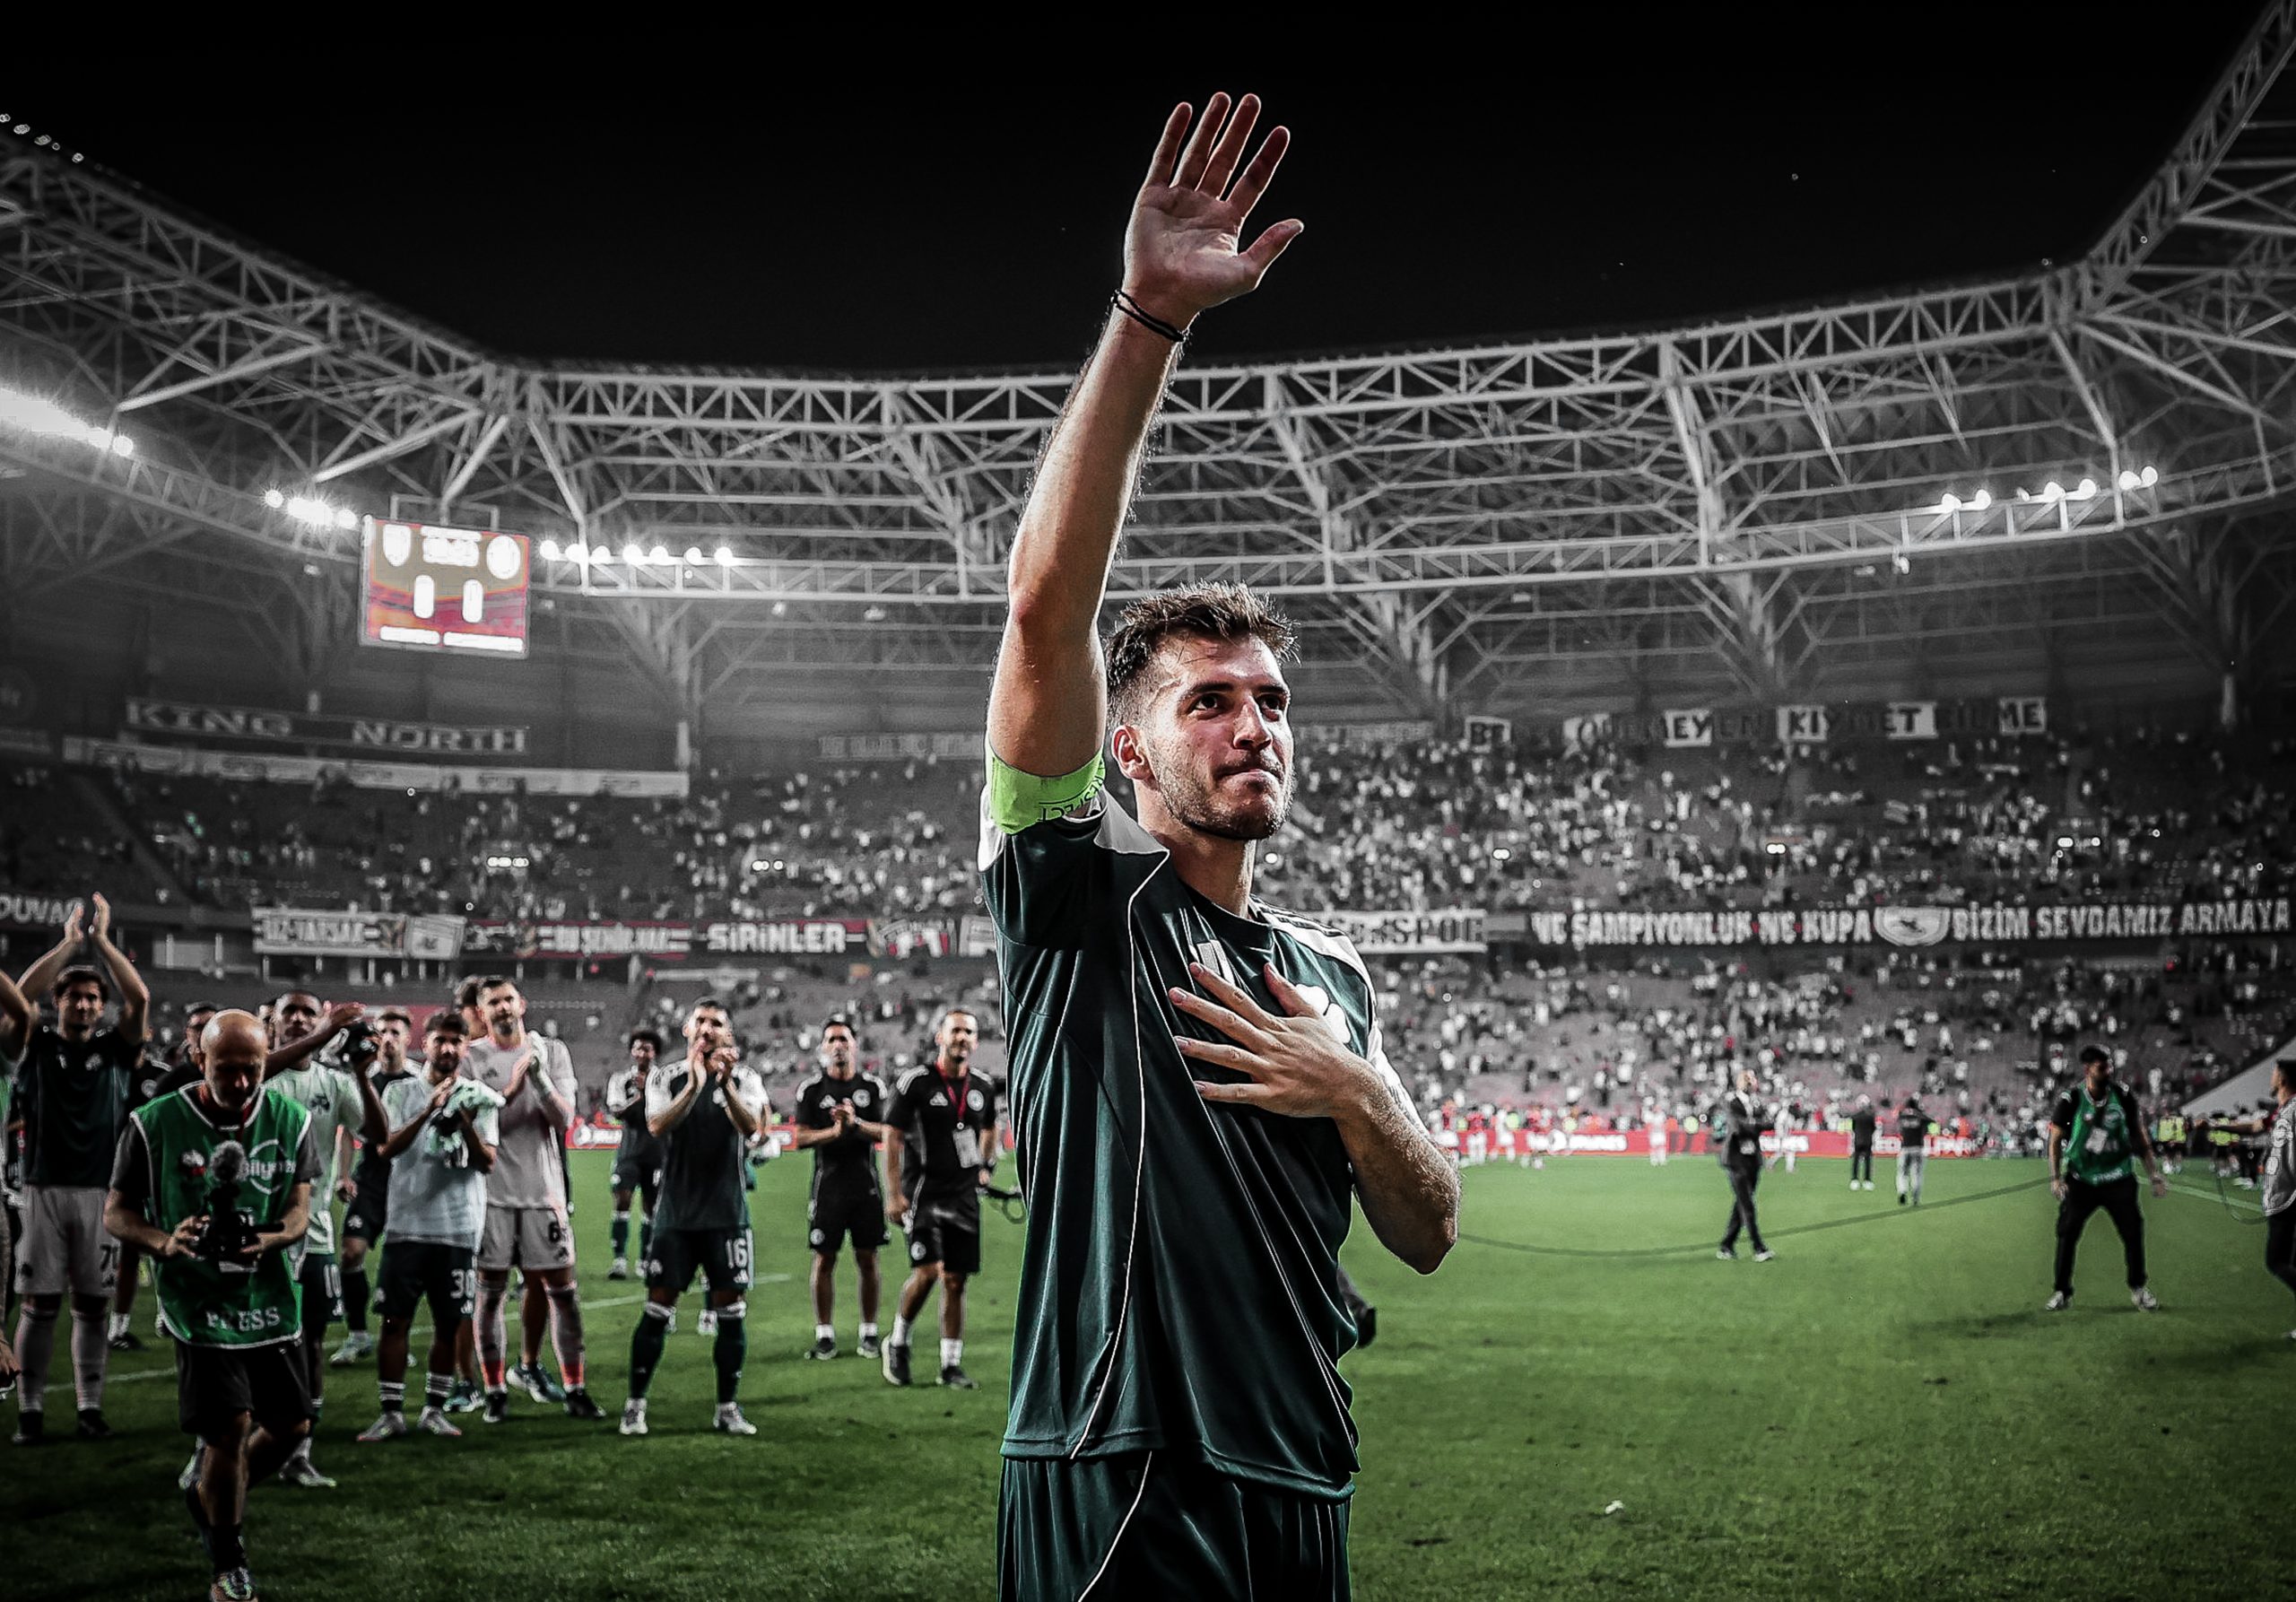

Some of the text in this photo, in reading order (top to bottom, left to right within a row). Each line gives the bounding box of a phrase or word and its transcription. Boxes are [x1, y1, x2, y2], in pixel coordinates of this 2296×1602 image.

[127, 701, 526, 753] KING NORTH
[1802, 910, 1873, 943] KUPA
[2180, 899, 2291, 936] ARMAYA
[725, 1238, 748, 1269] 16
[450, 1268, 476, 1300] 30
